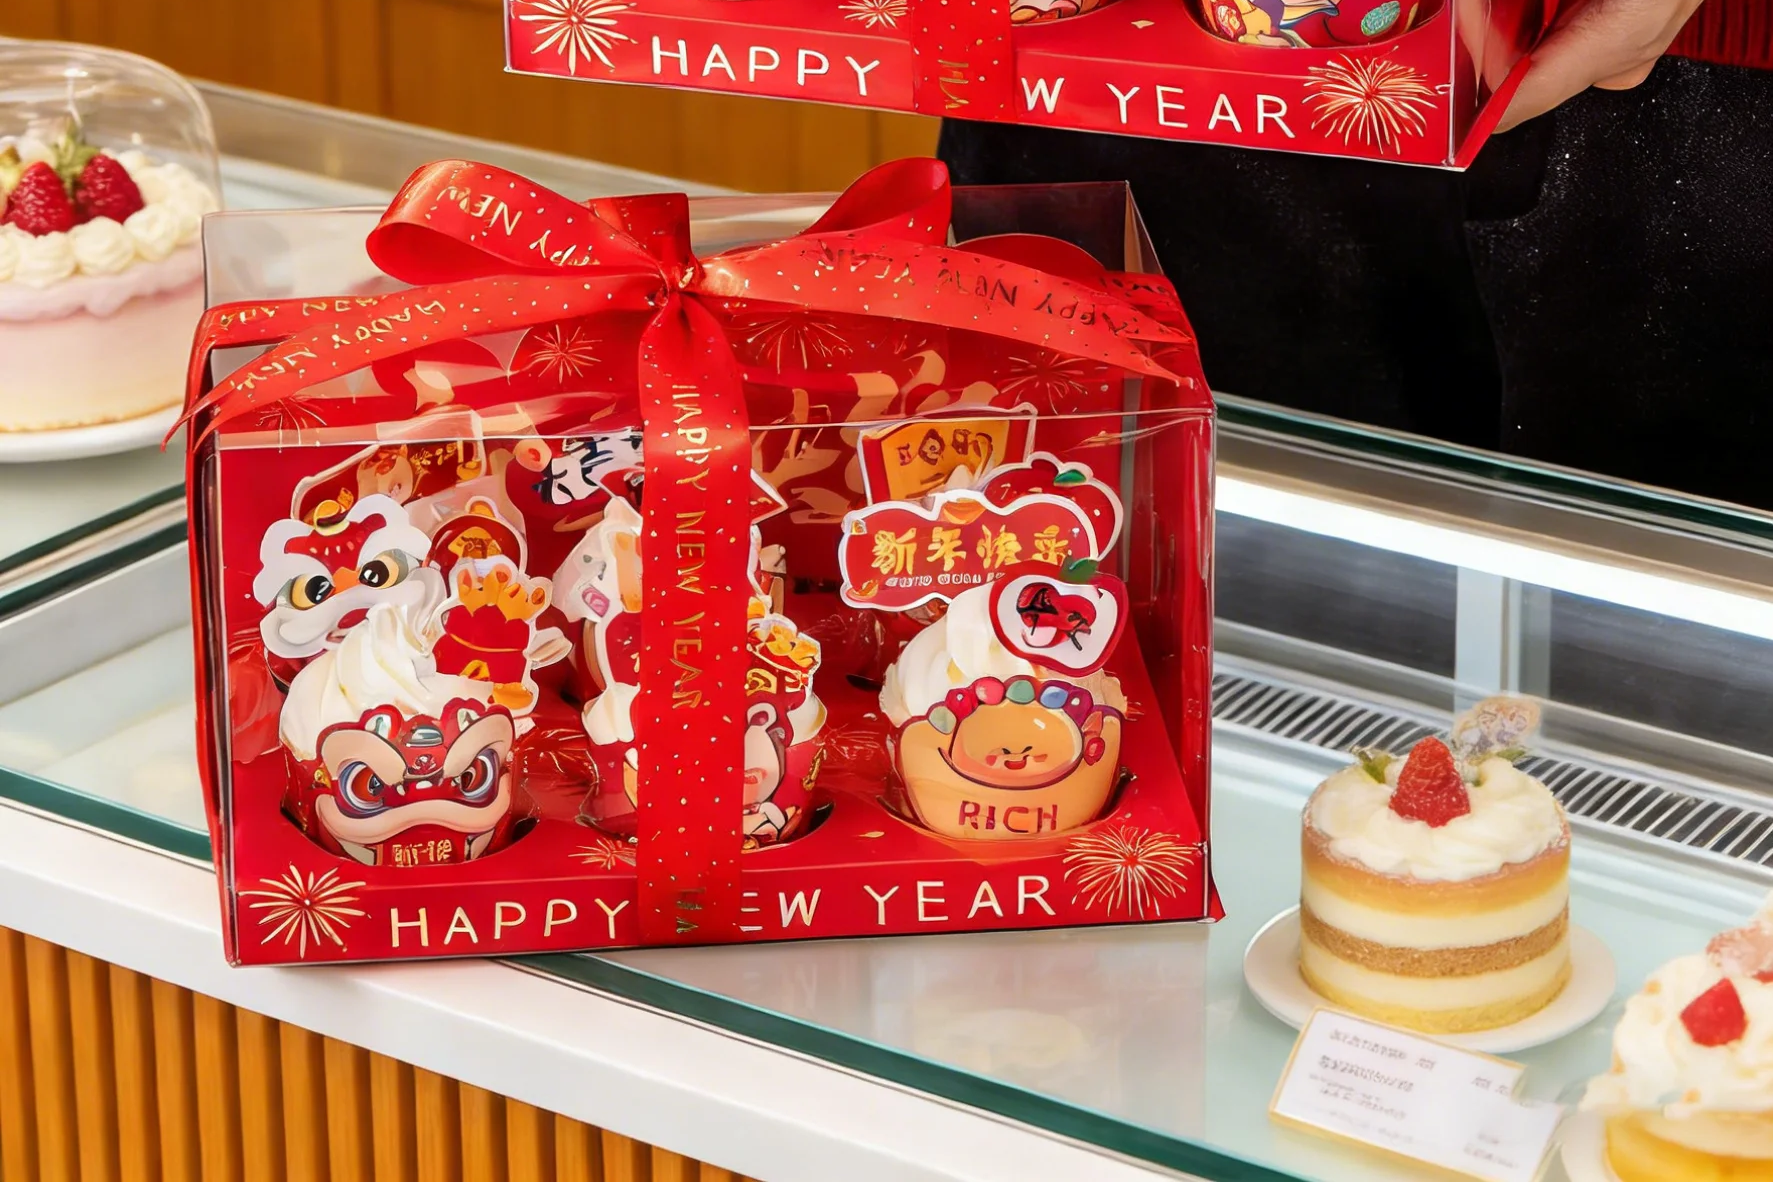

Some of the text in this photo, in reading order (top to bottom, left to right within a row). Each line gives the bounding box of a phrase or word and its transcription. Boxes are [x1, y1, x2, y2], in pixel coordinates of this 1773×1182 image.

[651, 35, 880, 97] HAPPY
[1106, 82, 1296, 139] YEAR
[675, 510, 705, 595] NEW
[957, 799, 1059, 834] RICH
[390, 899, 629, 947] HAPPY
[740, 888, 821, 932] EW
[864, 874, 1056, 926] YEAR
